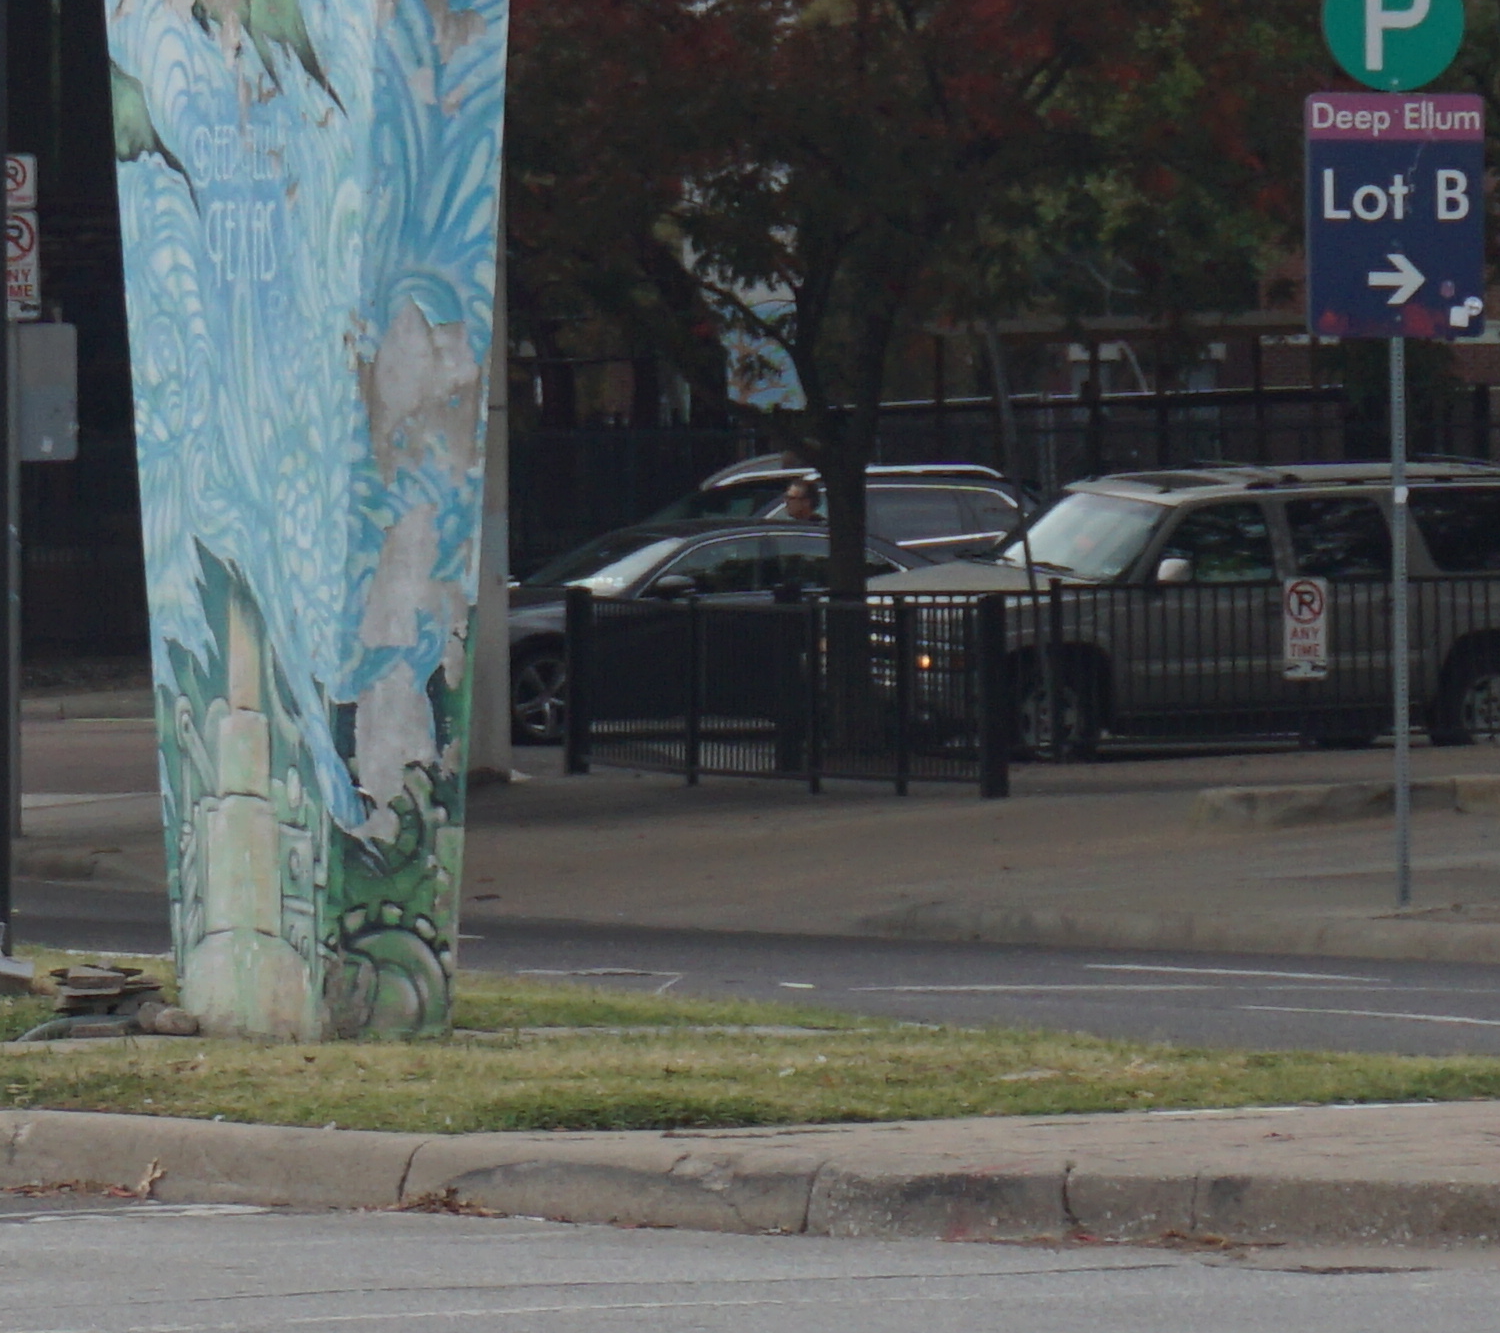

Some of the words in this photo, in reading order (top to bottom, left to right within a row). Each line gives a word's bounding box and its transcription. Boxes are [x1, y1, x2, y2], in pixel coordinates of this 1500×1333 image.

[1312, 102, 1391, 137] Deep
[1404, 100, 1481, 131] Ellum
[1323, 169, 1409, 220] Lot
[1436, 169, 1470, 220] B
[6, 269, 32, 283] NY
